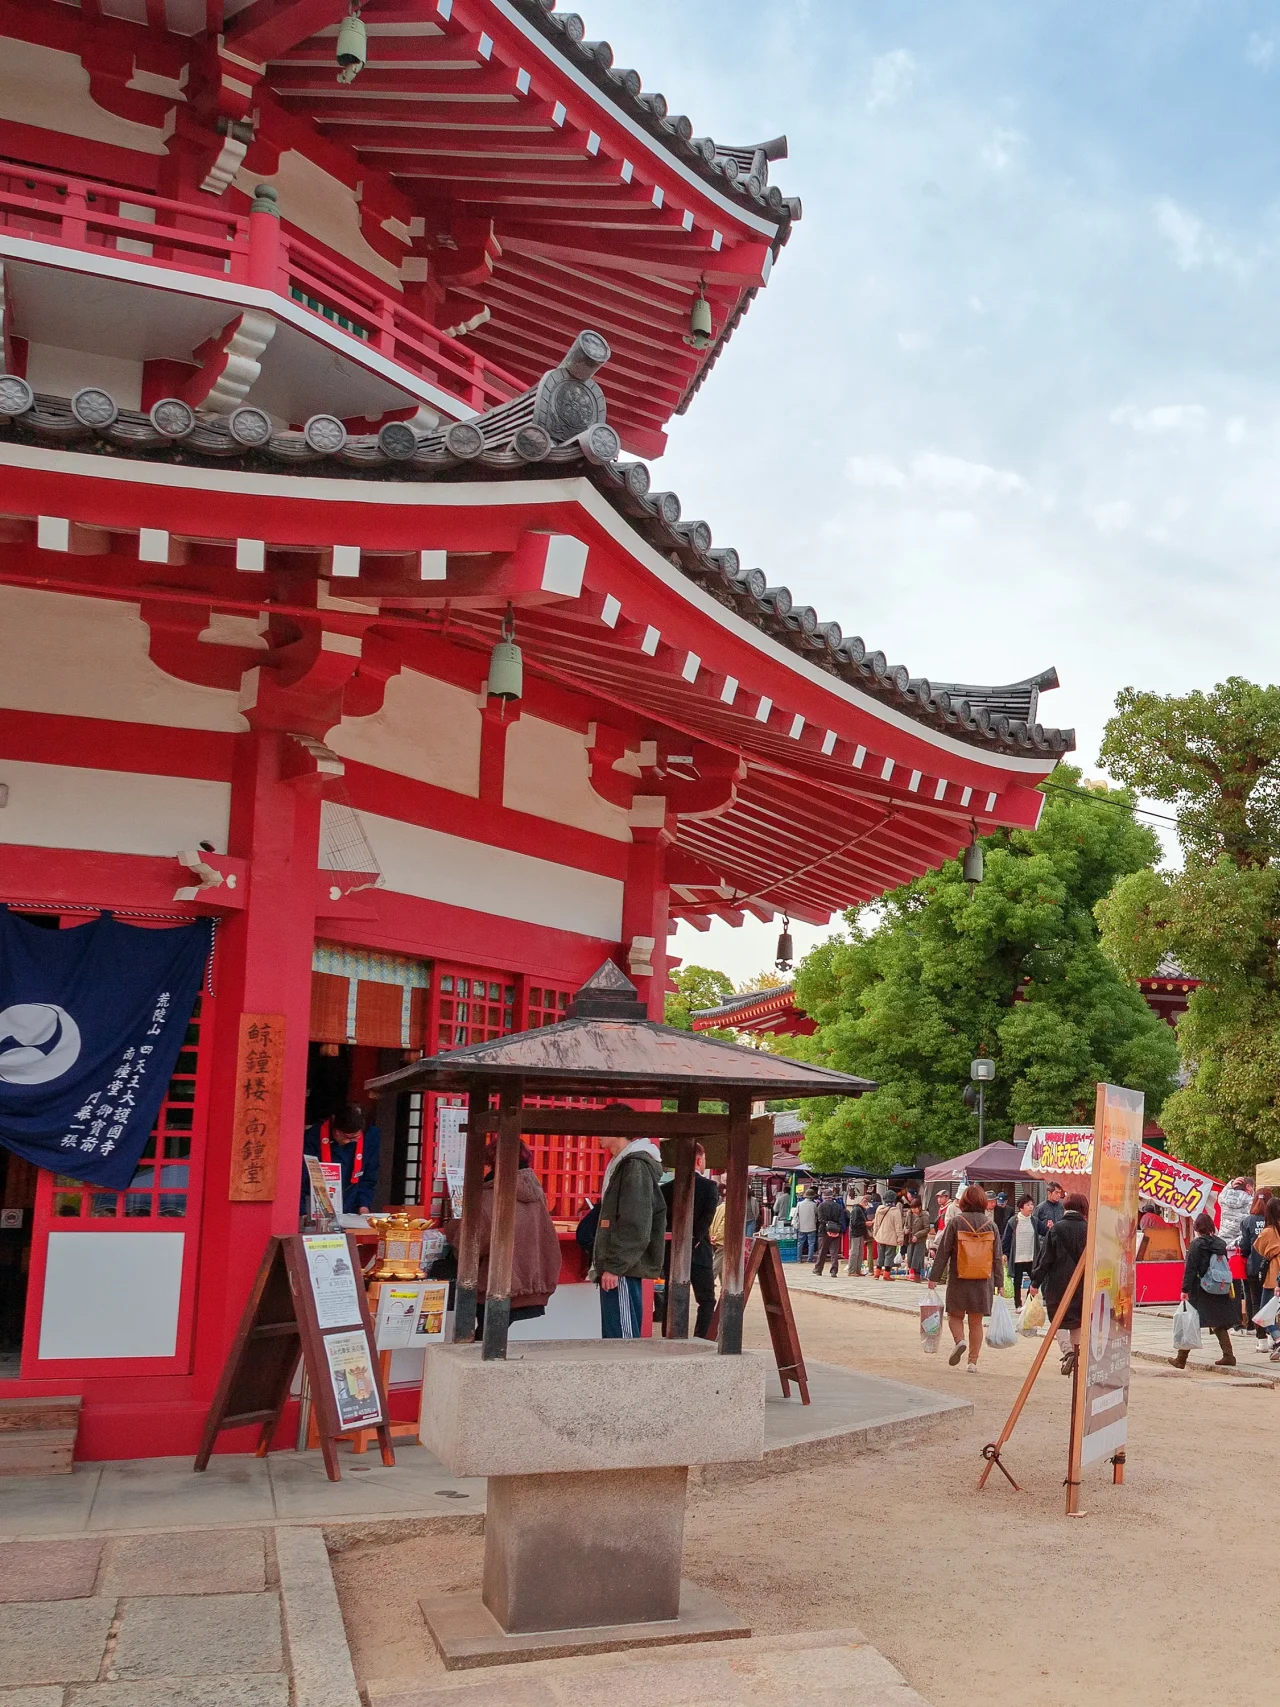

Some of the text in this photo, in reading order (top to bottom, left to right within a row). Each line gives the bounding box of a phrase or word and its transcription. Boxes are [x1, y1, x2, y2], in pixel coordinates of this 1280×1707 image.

[99, 991, 171, 1157] 荒陵山 四天王大護國寺
